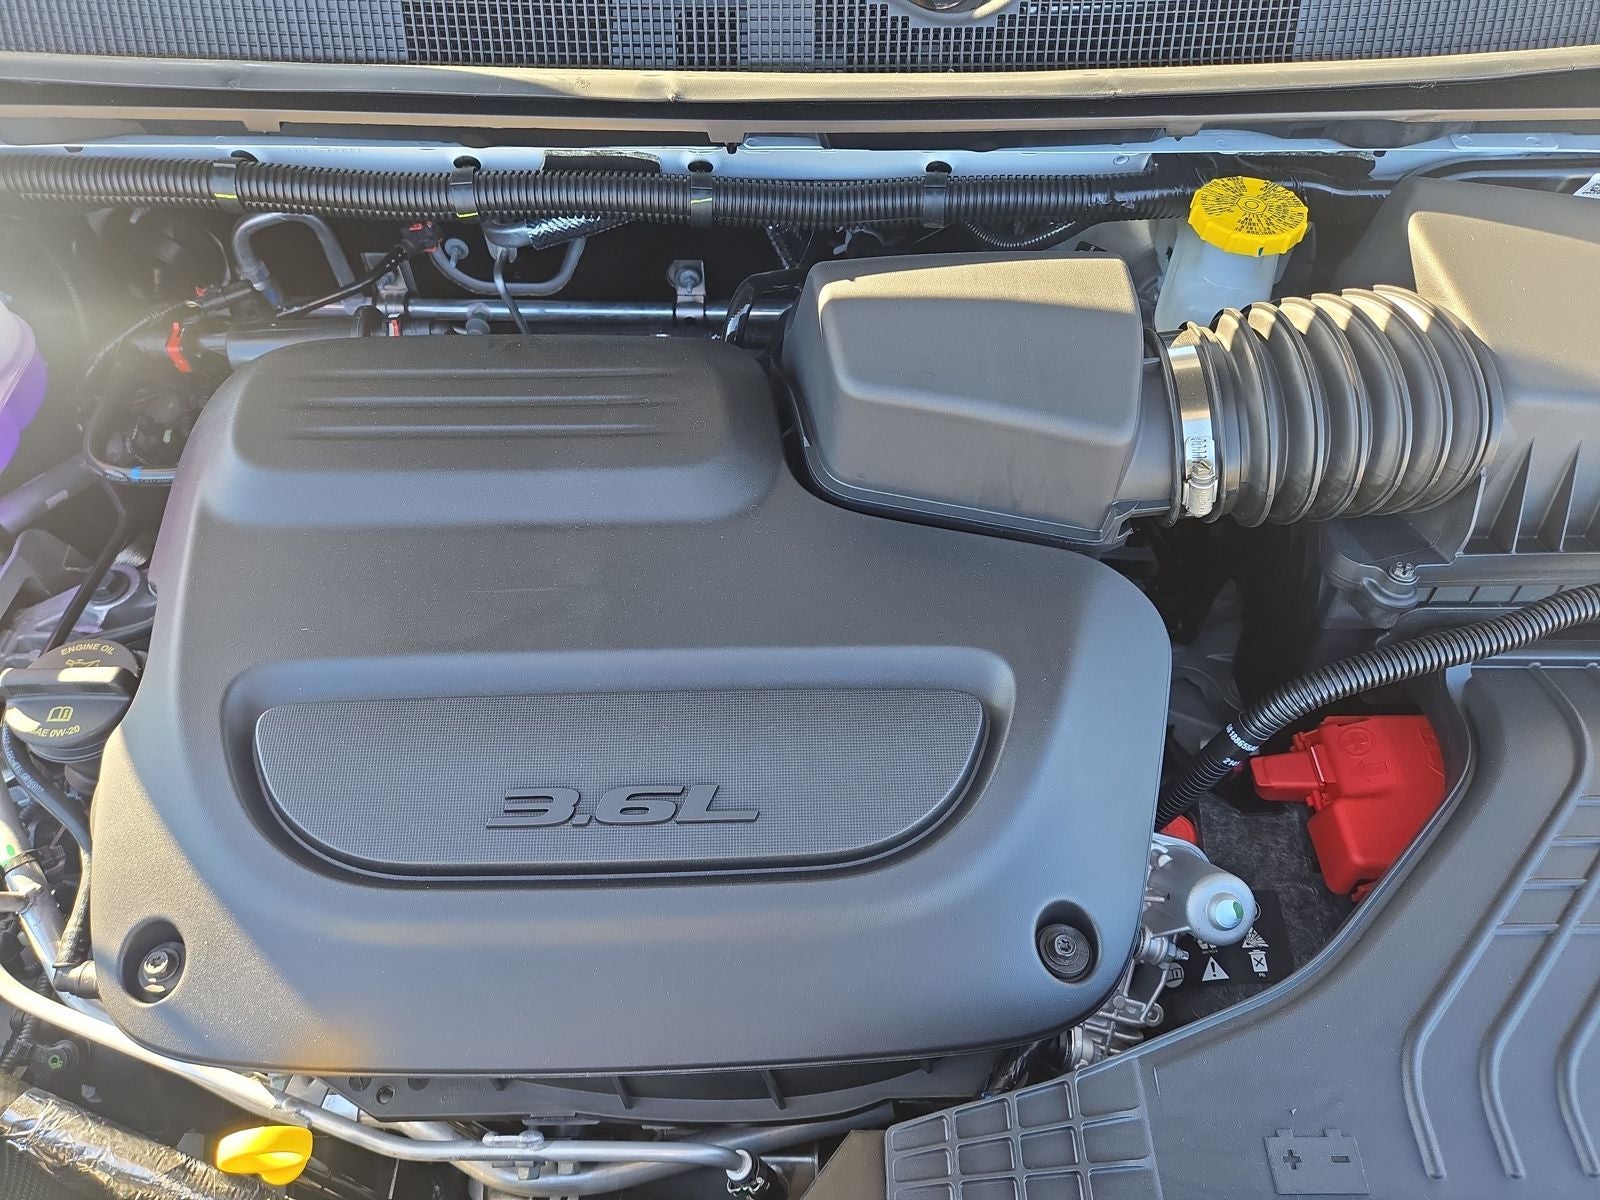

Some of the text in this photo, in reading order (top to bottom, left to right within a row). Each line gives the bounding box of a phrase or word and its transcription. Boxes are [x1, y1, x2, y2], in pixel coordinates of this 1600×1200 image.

[61, 643, 115, 656] ENGINE OIL
[486, 784, 760, 829] 3.6L
